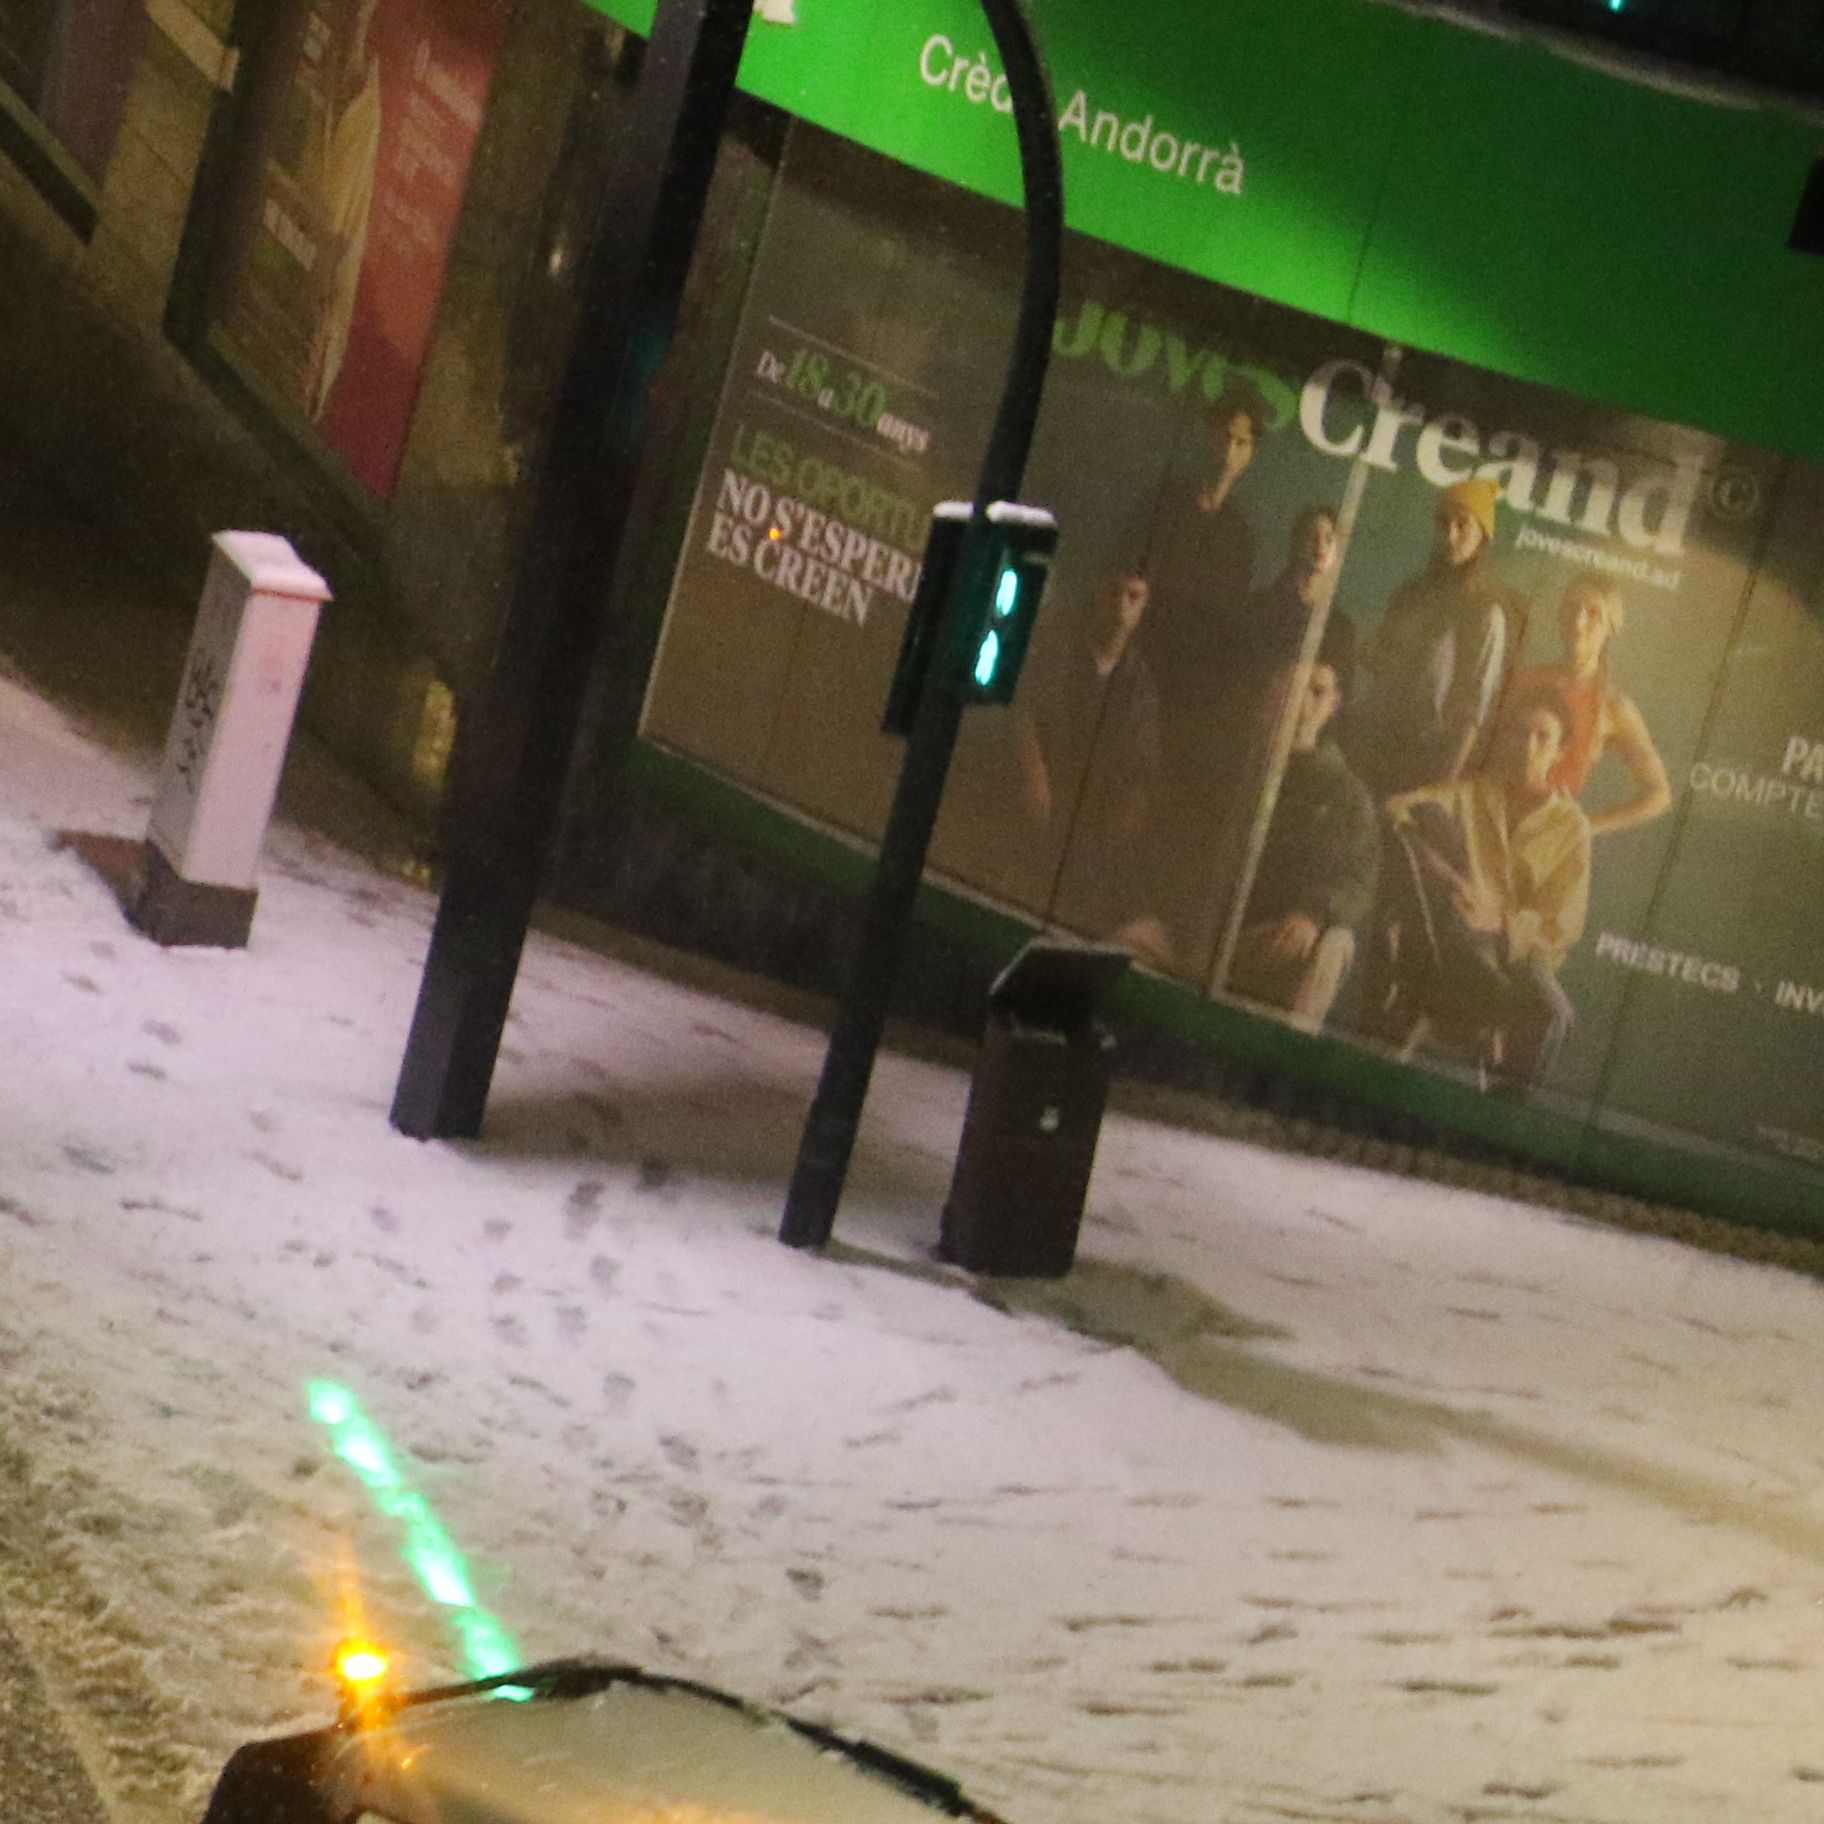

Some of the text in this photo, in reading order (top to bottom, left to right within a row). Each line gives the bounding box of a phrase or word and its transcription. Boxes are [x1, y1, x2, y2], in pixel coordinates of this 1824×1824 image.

[1058, 88, 1246, 195] Andorrà
[718, 467, 772, 526] NO
[1299, 358, 1705, 556] Creand
[707, 511, 873, 627] ES CREEN
[1595, 929, 1743, 994] PRESTECS
